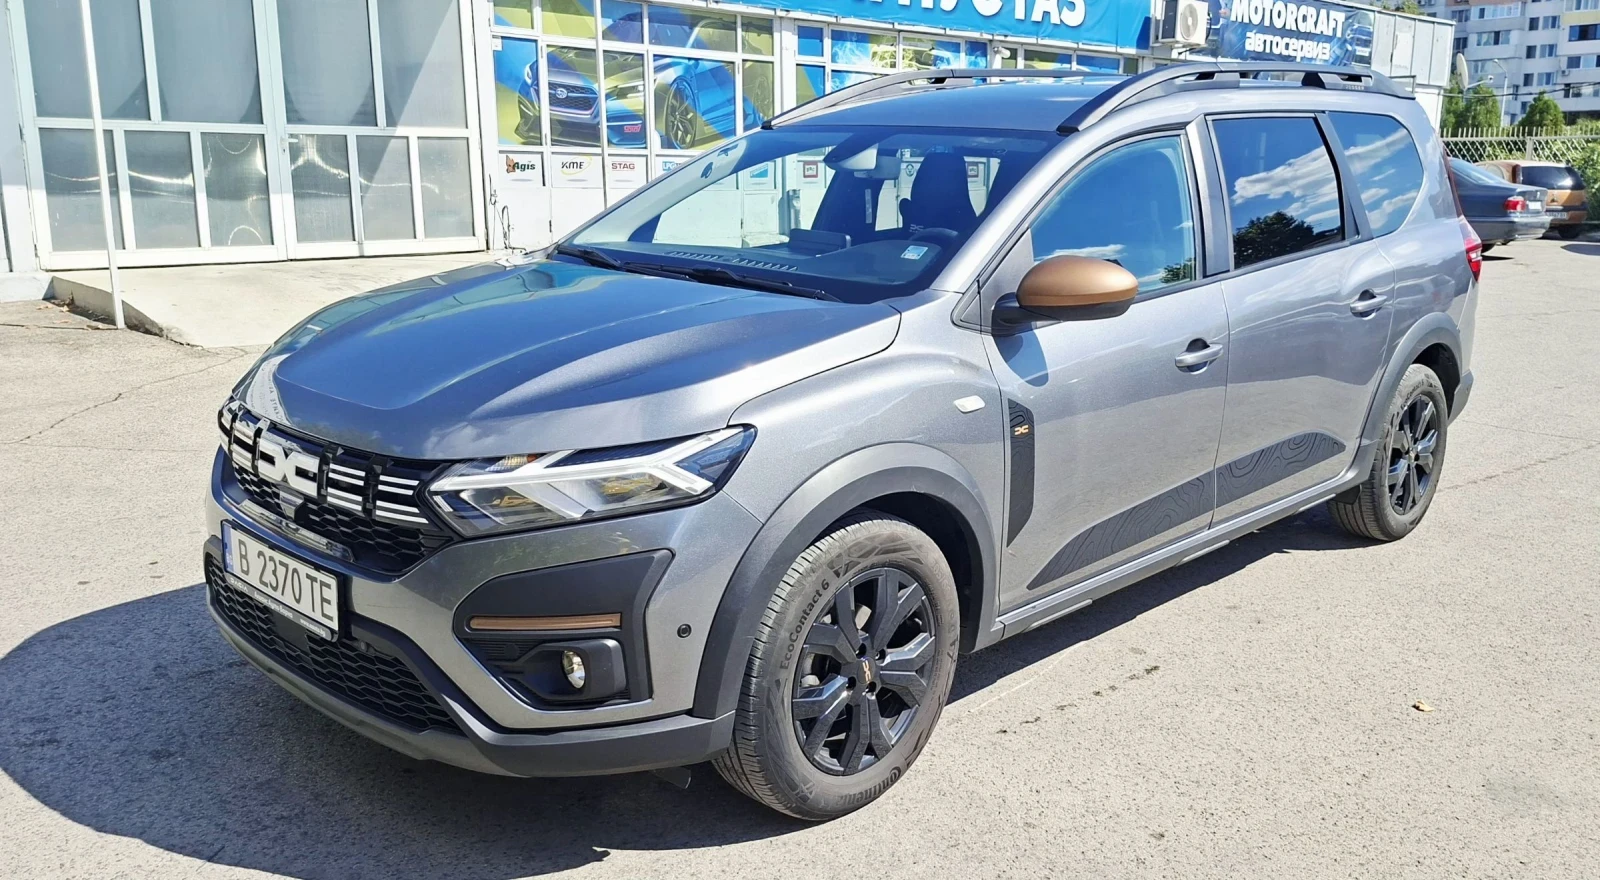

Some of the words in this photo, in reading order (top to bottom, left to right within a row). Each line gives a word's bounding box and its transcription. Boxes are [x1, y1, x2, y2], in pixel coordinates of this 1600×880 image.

[1230, 0, 1346, 38] MOTORCRAFT
[1245, 31, 1331, 62] автосервиз
[513, 160, 536, 172] Agis
[561, 161, 585, 170] KME
[611, 162, 636, 170] STAG
[238, 538, 250, 576] B
[257, 550, 302, 605] 2370
[305, 572, 334, 622] TE
[780, 589, 823, 670] EcoContact
[821, 578, 831, 591] 6
